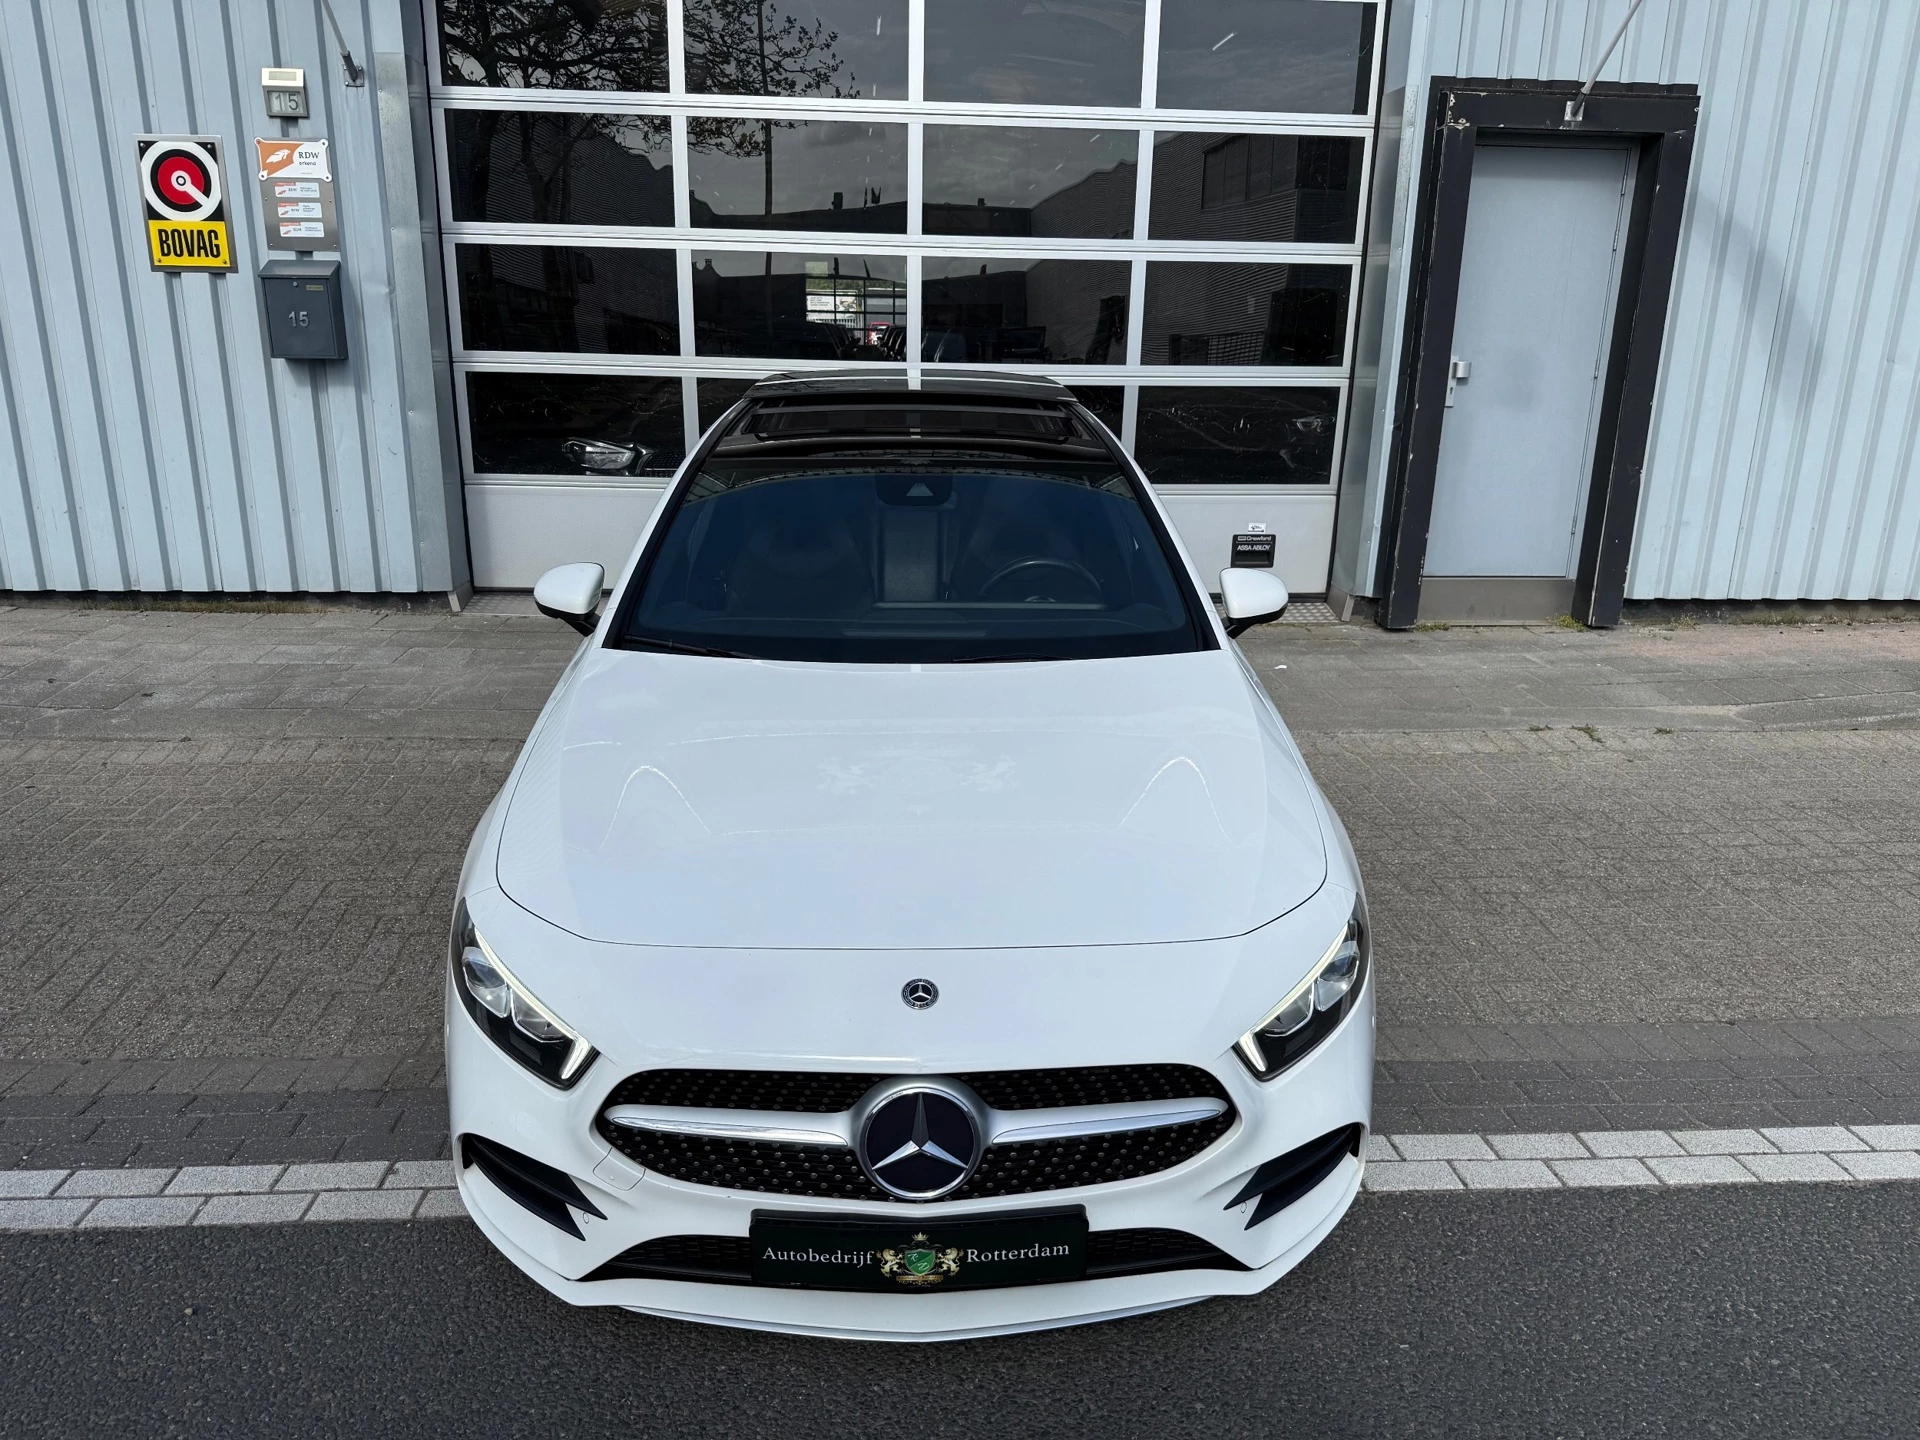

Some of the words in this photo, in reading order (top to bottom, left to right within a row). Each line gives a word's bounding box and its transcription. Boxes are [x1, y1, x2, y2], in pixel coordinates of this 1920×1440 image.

[274, 93, 299, 111] 15
[298, 151, 320, 159] RDW
[157, 228, 221, 258] BOVAG
[288, 311, 309, 327] 15
[762, 1247, 875, 1269] Autobedrijf
[966, 1243, 1070, 1263] Rotterdam
